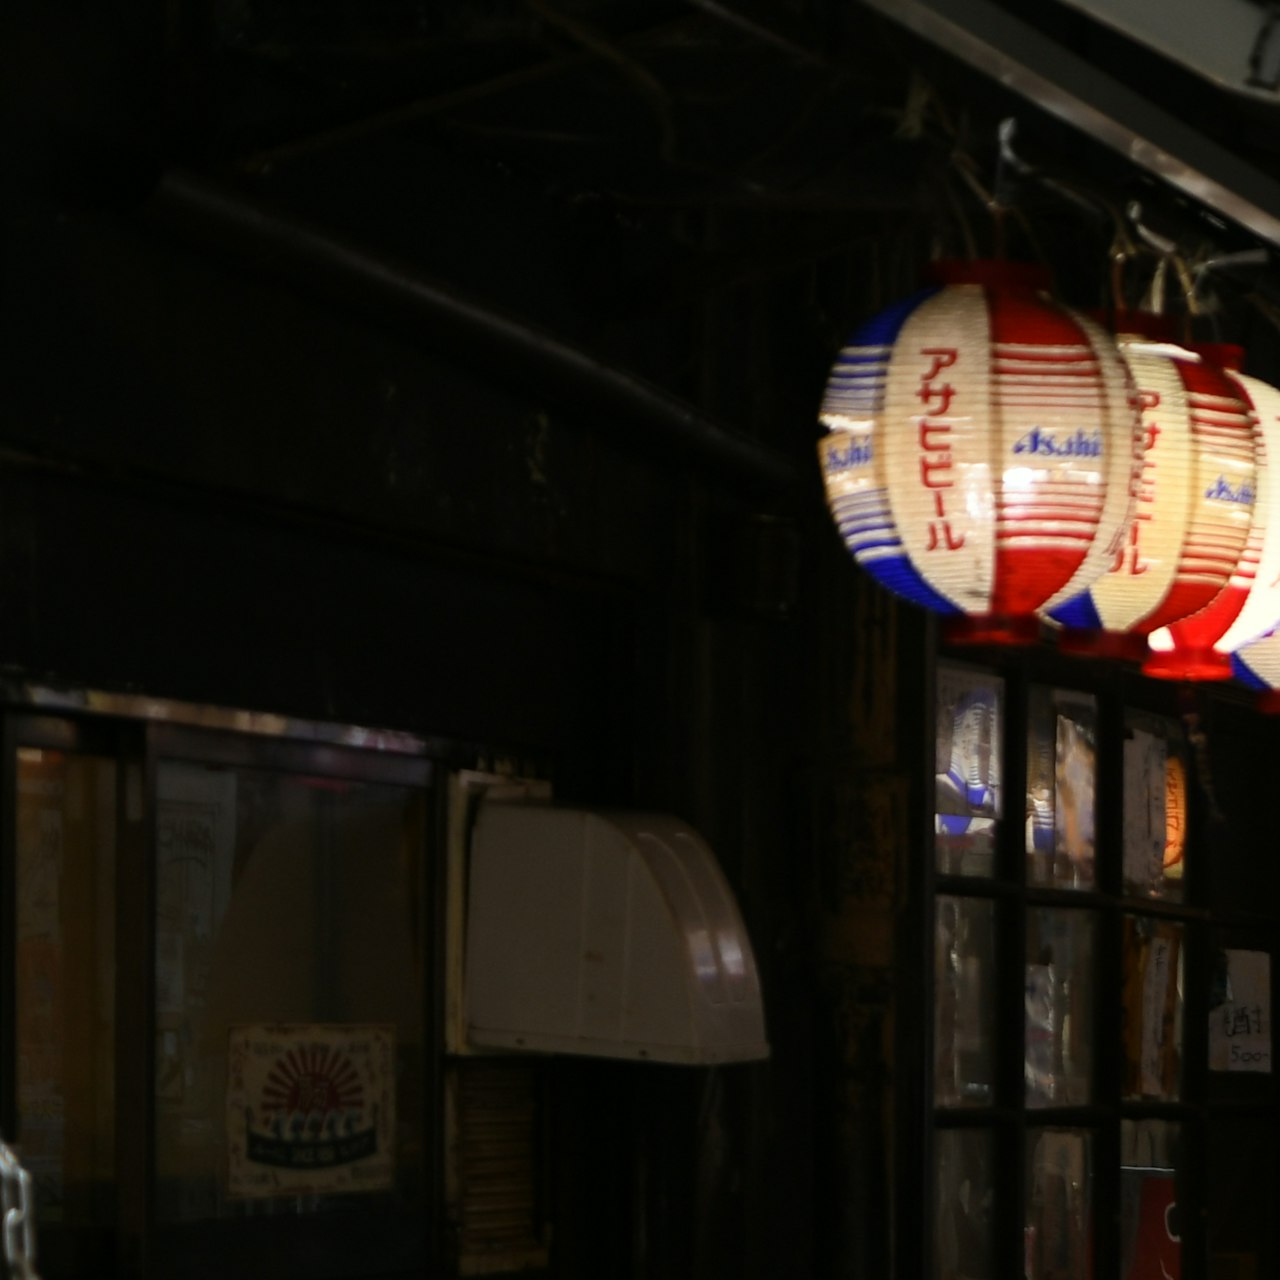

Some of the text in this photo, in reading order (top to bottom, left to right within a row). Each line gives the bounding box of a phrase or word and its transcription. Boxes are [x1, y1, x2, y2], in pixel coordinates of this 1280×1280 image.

[825, 436, 872, 471] sahi
[916, 348, 965, 551] アサヒビール
[1012, 425, 1102, 457] Asahi
